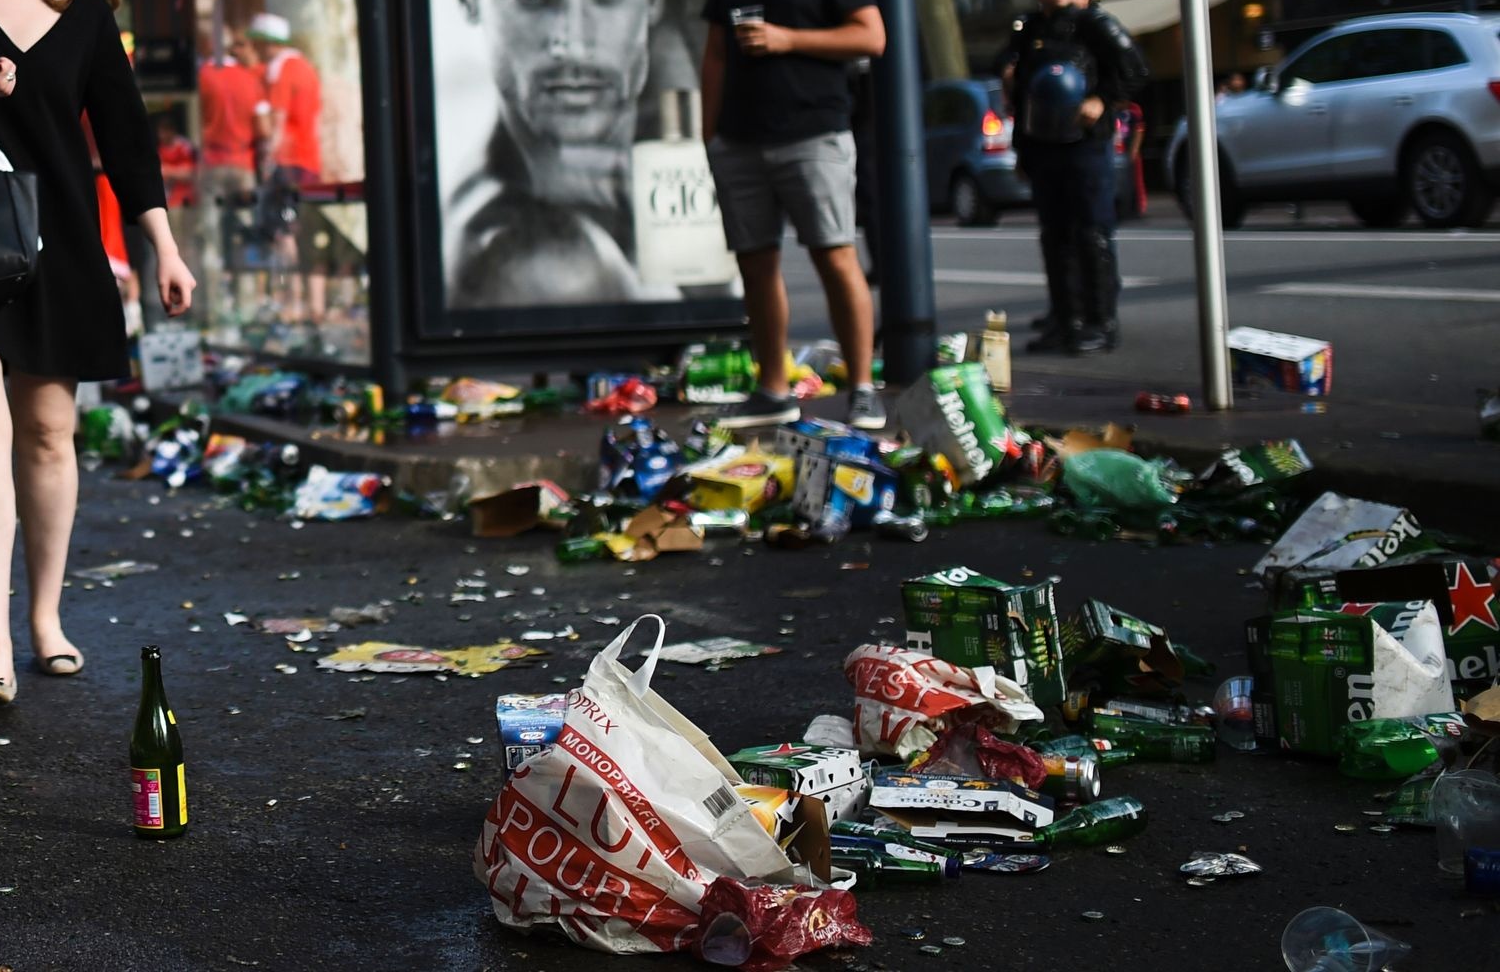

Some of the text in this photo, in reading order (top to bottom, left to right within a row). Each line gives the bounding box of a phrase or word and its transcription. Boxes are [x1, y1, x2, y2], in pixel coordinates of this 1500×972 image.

[561, 731, 662, 832] MONOPRIX.FR
[899, 797, 982, 808] Corona
[500, 800, 633, 914] POUR
